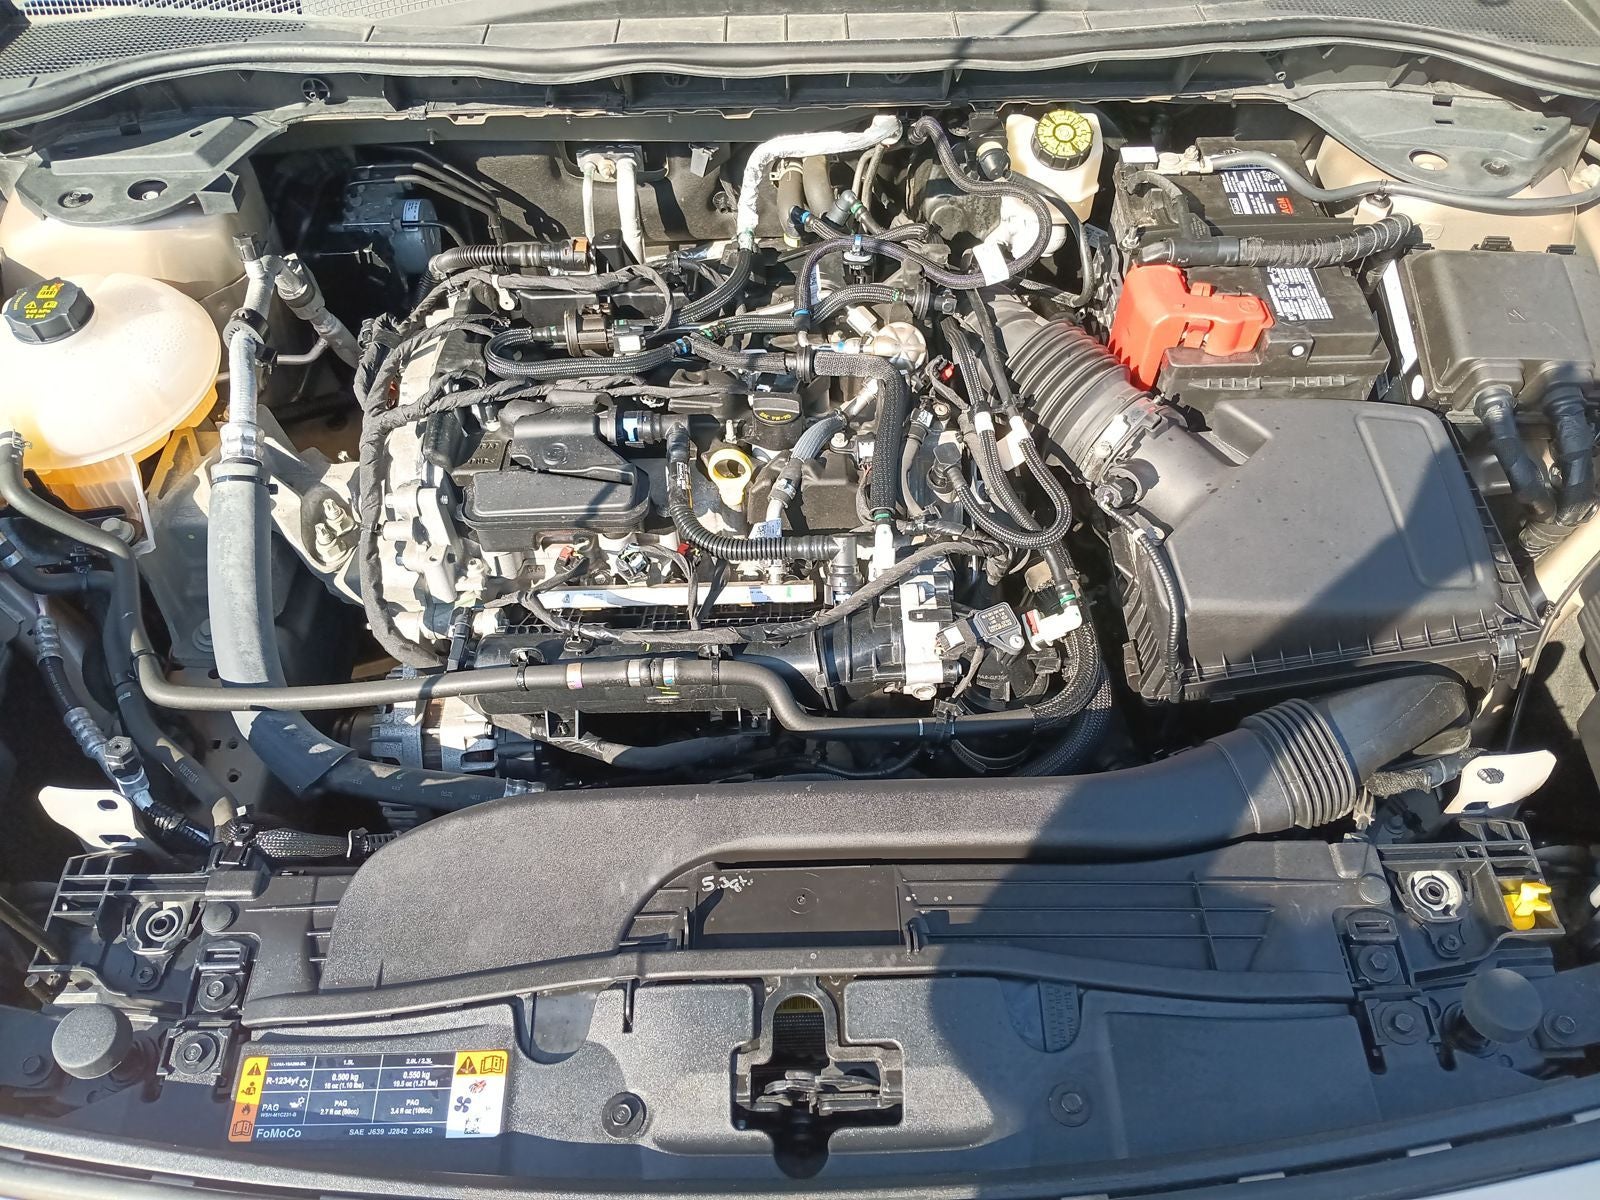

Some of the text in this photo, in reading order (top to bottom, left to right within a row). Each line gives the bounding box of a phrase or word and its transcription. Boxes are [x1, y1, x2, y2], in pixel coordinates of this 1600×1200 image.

[1276, 197, 1291, 216] AGM
[331, 1073, 359, 1082] 0.500 kg
[403, 1071, 431, 1080] 0.550 kg
[266, 1076, 299, 1086] R-1234yf
[261, 1104, 279, 1112] PAG
[256, 1127, 302, 1138] FoMoCo
[349, 1128, 365, 1136] SAE
[367, 1128, 385, 1136] J639
[412, 1127, 433, 1135] J2845
